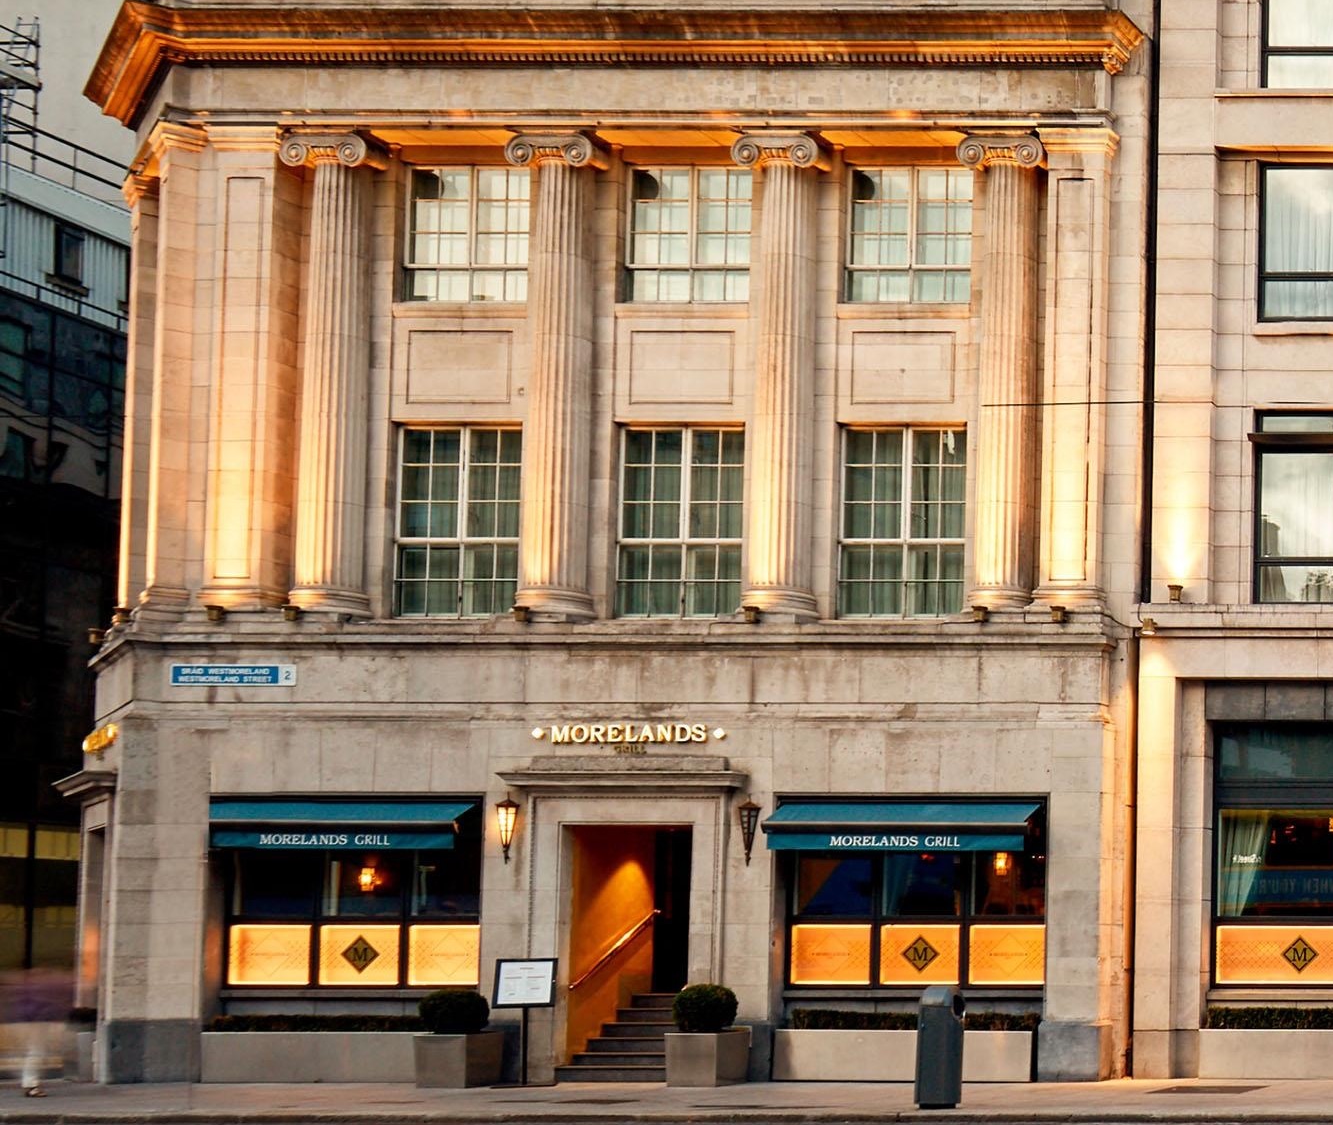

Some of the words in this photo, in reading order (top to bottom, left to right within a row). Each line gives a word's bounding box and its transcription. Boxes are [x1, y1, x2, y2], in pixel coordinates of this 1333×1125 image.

[178, 675, 239, 683] WESTMORELAND
[284, 670, 291, 680] 2
[551, 724, 708, 744] MORELANDS
[614, 745, 647, 755] GRILL
[259, 833, 348, 845] MORELANDS
[354, 834, 391, 846] GRILL
[829, 835, 919, 847] MORELANDS
[924, 835, 961, 847] GRILL
[352, 947, 368, 962] M
[912, 947, 928, 962] M
[1292, 947, 1308, 962] M
